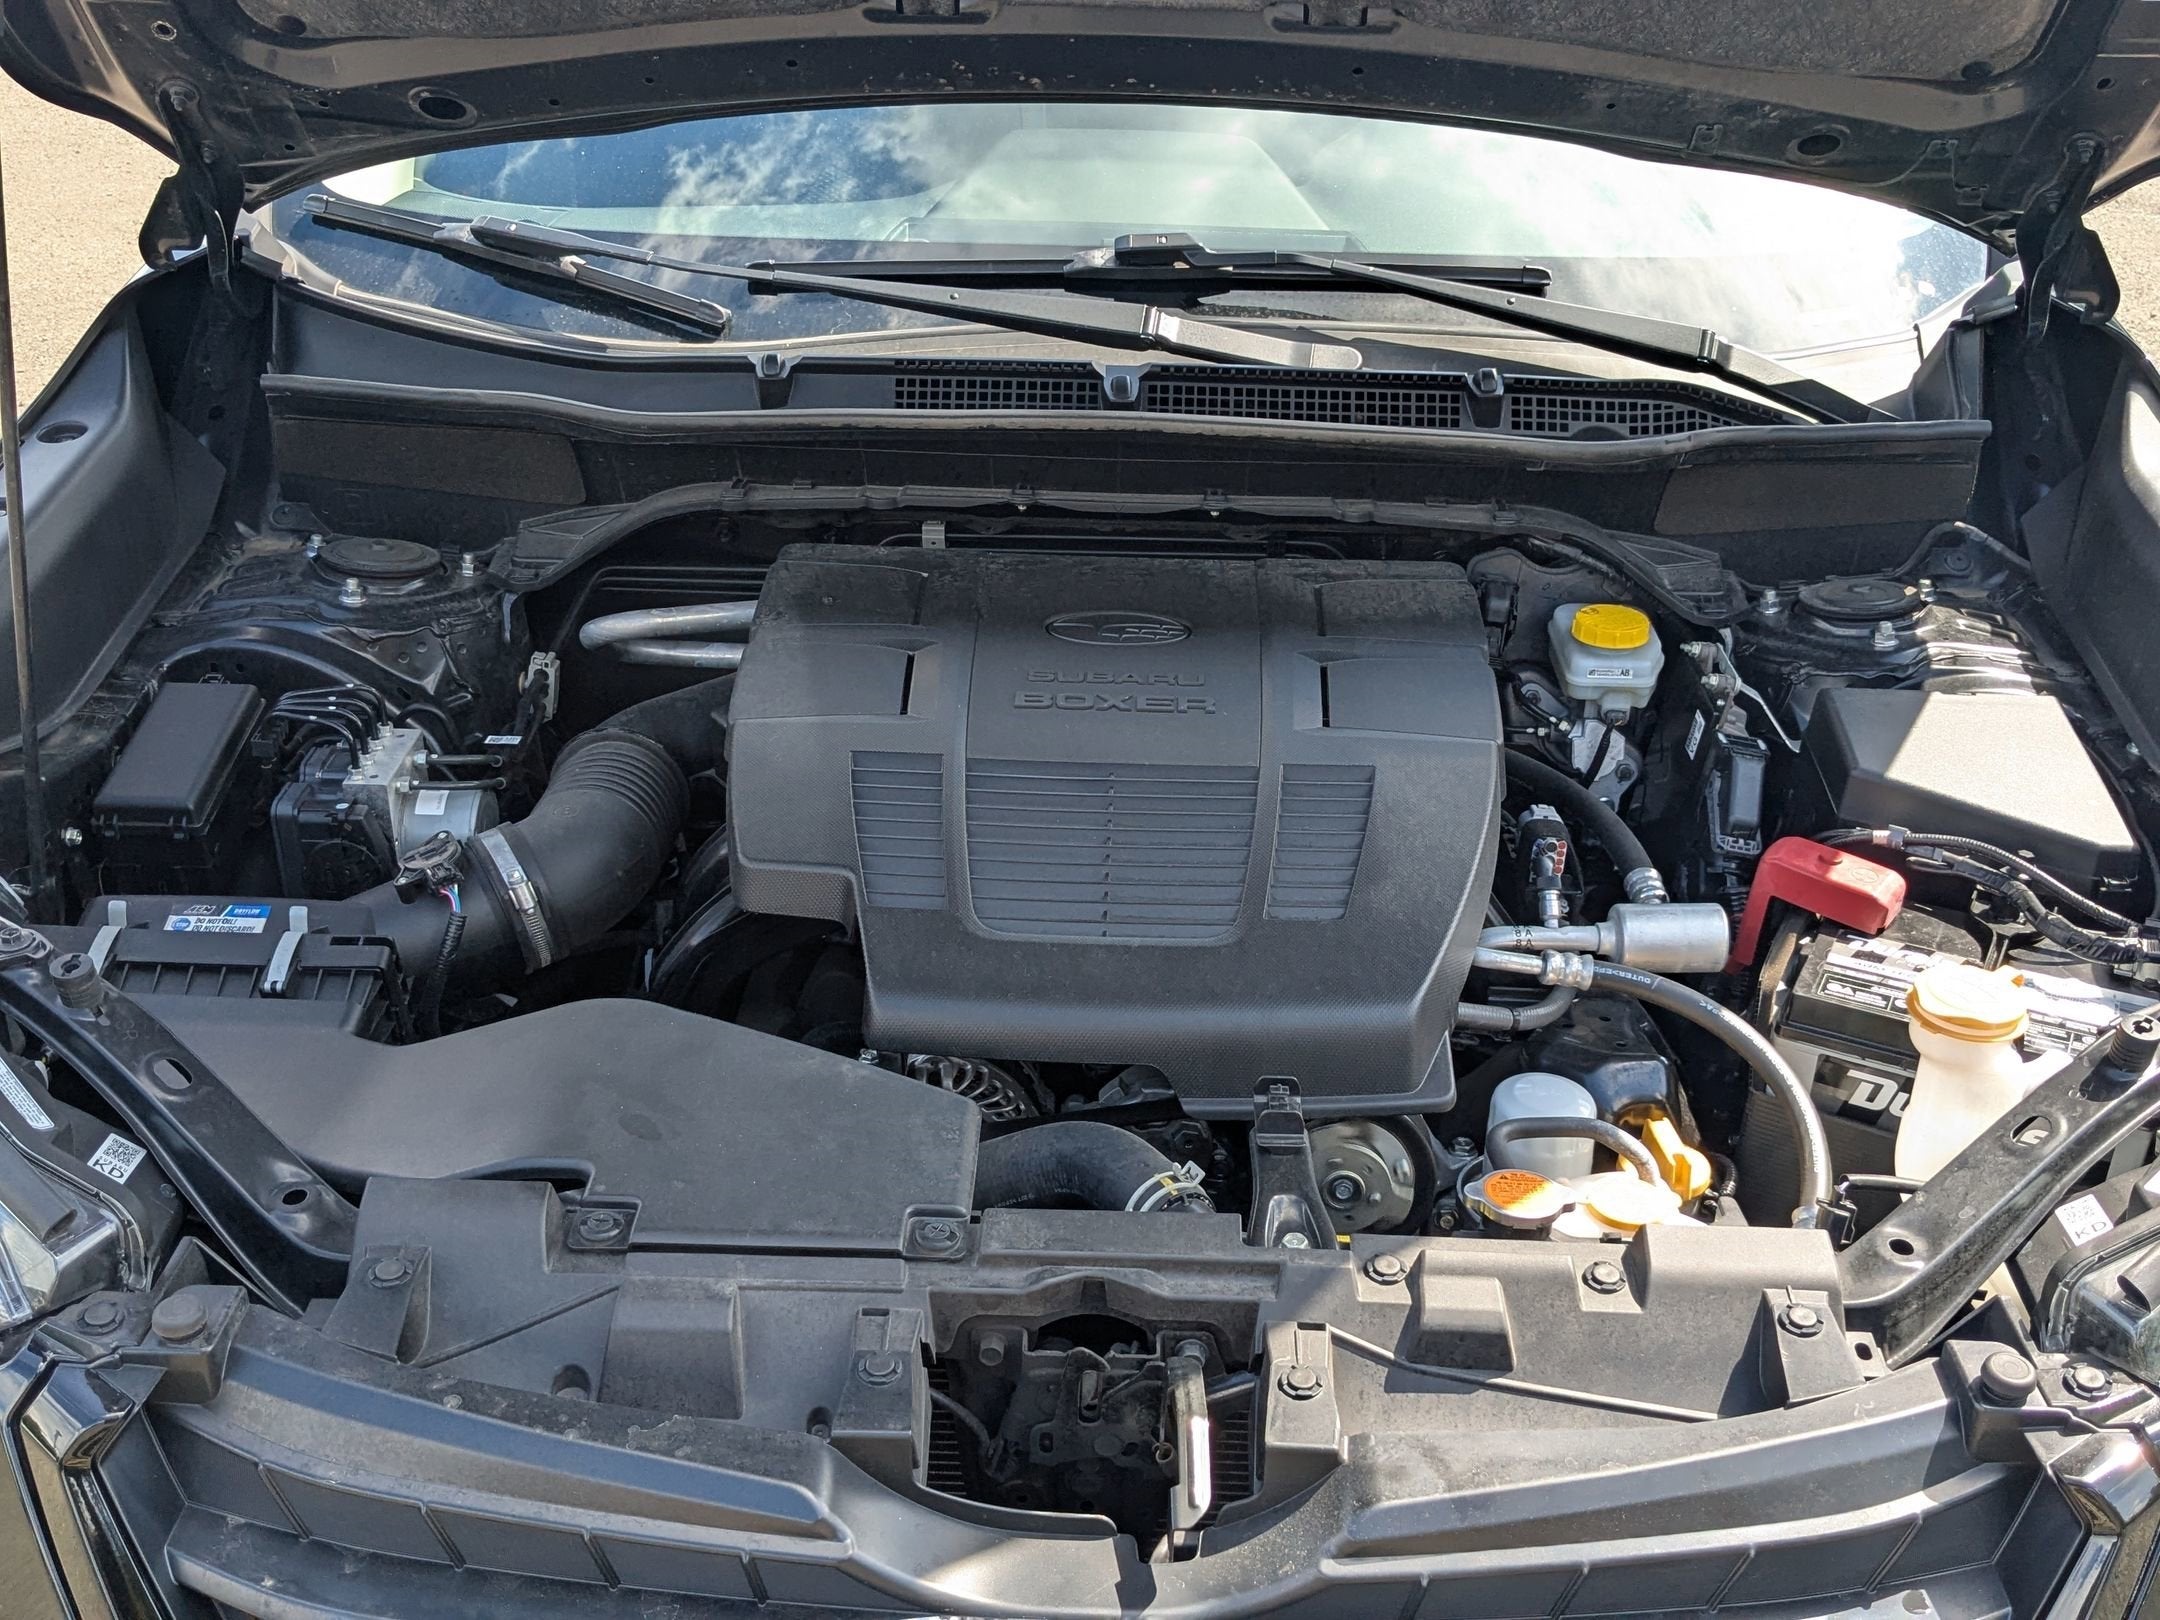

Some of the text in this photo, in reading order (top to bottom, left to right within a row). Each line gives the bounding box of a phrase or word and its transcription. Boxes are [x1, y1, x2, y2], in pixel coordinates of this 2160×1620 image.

[1027, 671, 1206, 687] SUBARU
[1013, 691, 1216, 715] BOXER
[194, 917, 206, 925] DO
[93, 1159, 124, 1178] KD
[2074, 1221, 2107, 1239] KD
